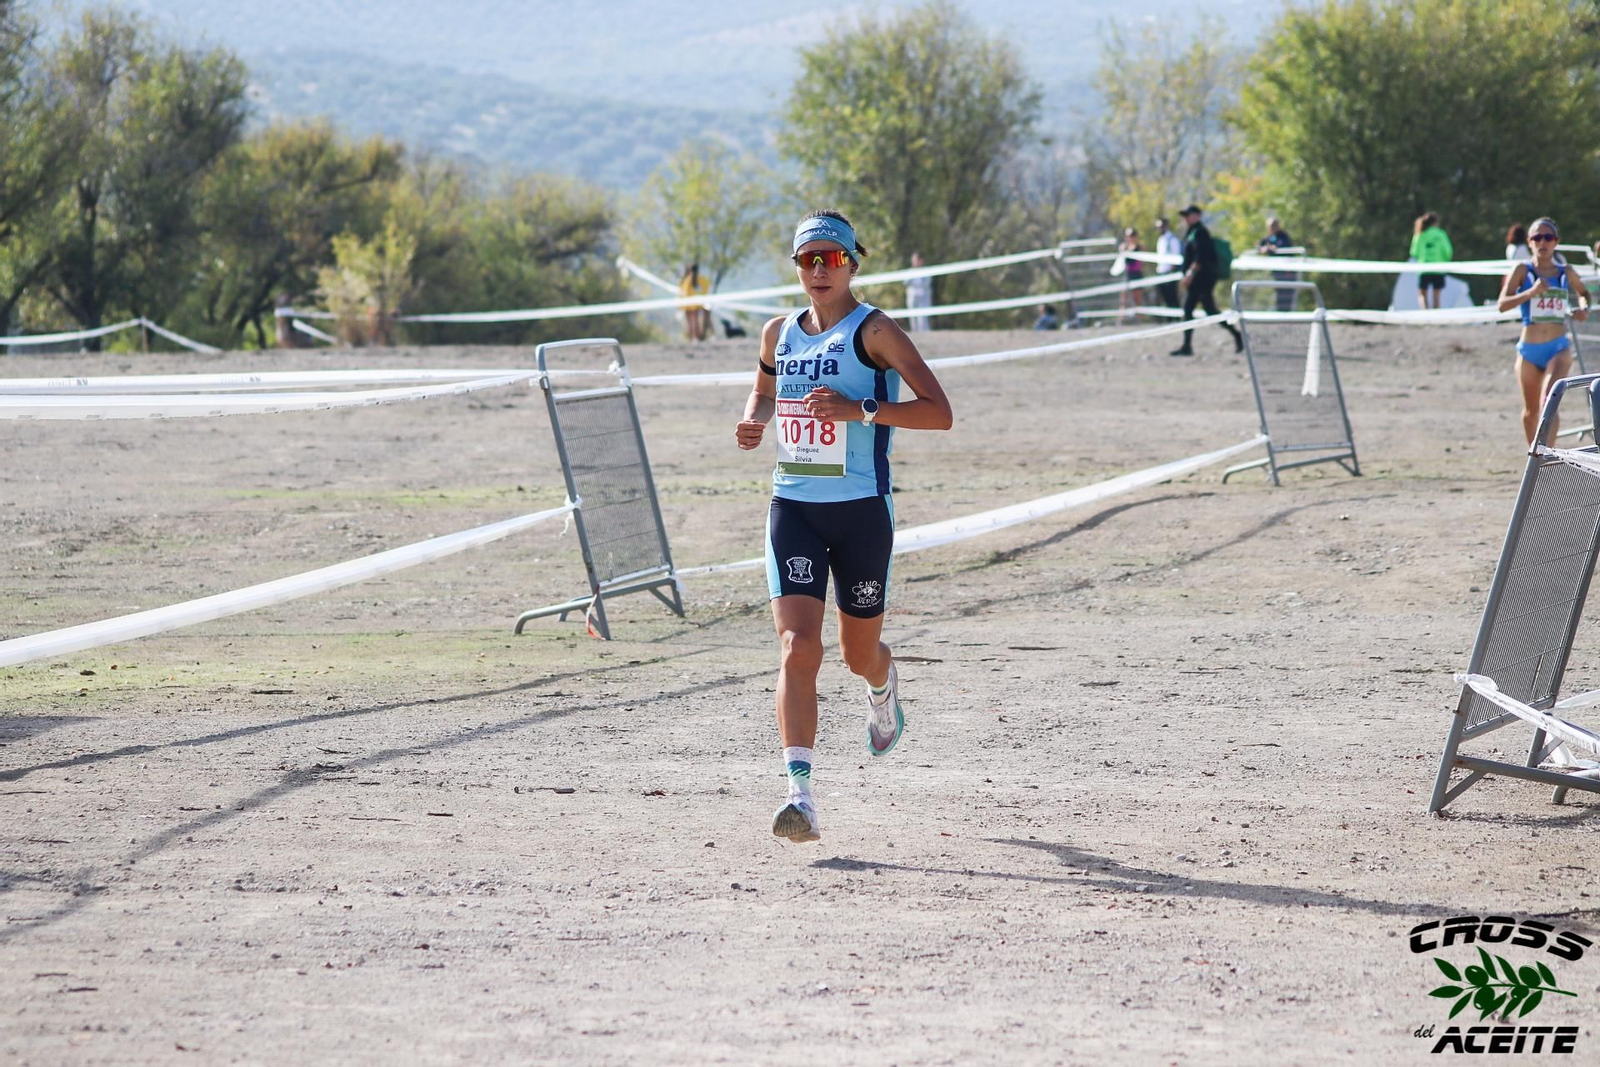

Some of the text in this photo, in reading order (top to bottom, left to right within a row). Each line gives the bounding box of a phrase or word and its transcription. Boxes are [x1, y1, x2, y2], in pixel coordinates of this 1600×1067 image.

[1537, 297, 1563, 310] 449
[776, 353, 840, 381] nerja
[781, 419, 836, 446] 1018
